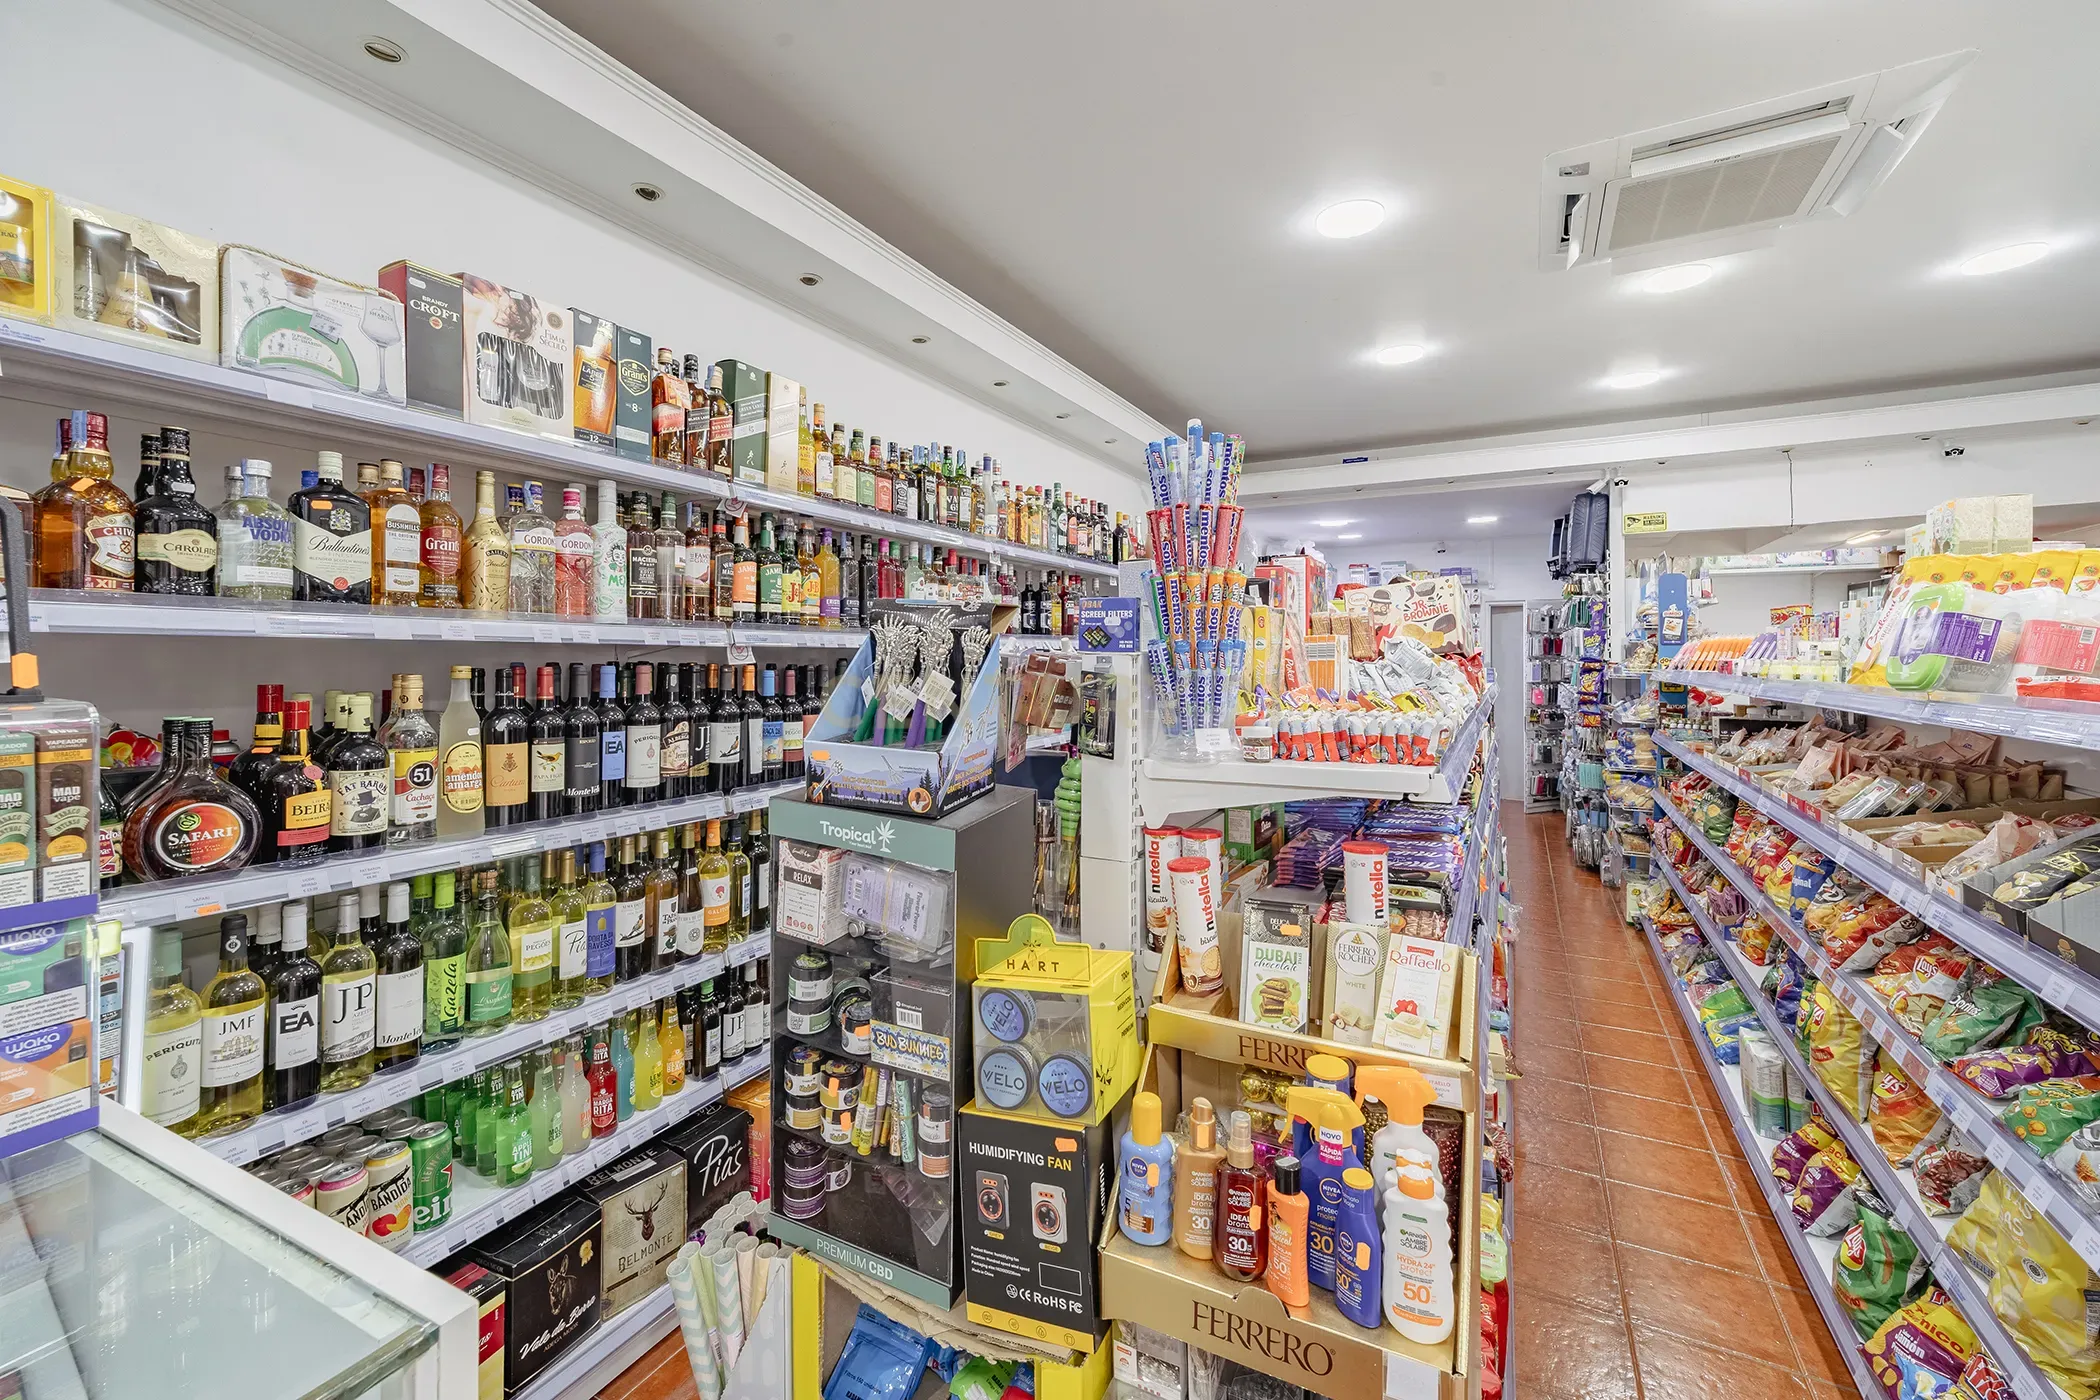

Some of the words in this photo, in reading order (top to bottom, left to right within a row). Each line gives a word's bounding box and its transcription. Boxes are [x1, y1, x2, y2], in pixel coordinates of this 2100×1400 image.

[421, 294, 448, 308] BRANDY
[409, 298, 460, 324] CROFT
[622, 366, 648, 382] Grant's
[632, 403, 638, 412] 8
[589, 434, 599, 444] 12
[1218, 442, 1233, 498] mentos
[387, 520, 420, 532] BUSHMILLS
[308, 535, 370, 556] Ballantine's
[1200, 510, 1212, 568] mentos
[96, 578, 117, 589] XII
[1080, 610, 1106, 618] SCREEN
[1108, 610, 1133, 619] FILTERS
[1156, 580, 1171, 635] mentos
[1170, 579, 1183, 635] mentos
[1403, 602, 1449, 622] BROWNIE
[1080, 618, 1086, 626] 3
[1197, 676, 1206, 729] mentos
[45, 738, 88, 746] VAPEADOR
[412, 769, 432, 783] 51
[53, 786, 81, 796] MAD
[338, 782, 358, 796] FAT
[359, 780, 388, 794] BARON
[566, 786, 590, 796] Monte
[53, 794, 82, 802] vape
[405, 792, 436, 803] Cachaça
[168, 827, 233, 847] SAFARI
[819, 820, 876, 845] Tropical
[1148, 840, 1160, 894] nutella
[793, 870, 812, 885] RELAX
[1370, 860, 1384, 920] nutella
[1198, 874, 1215, 932] nutella
[1256, 947, 1298, 964] DUBAI
[1338, 942, 1377, 958] FERRERO
[1006, 959, 1060, 972] HART
[1254, 958, 1298, 972] chocolate
[1338, 952, 1376, 966] ROCHER
[1389, 950, 1452, 973] Raffaello
[442, 959, 457, 1019] Gazela
[1345, 982, 1366, 990] WHITE
[332, 982, 373, 1024] JP
[1949, 995, 1984, 1016] Doritos
[280, 1011, 315, 1034] EA
[990, 998, 1015, 1032] VELO
[218, 1014, 256, 1036] JMF
[5, 1032, 60, 1054] waka
[381, 1032, 413, 1044] Monte
[876, 1031, 898, 1050] BUD
[898, 1036, 944, 1060] BUNNIES
[983, 1068, 1025, 1091] VELO
[1041, 1078, 1086, 1096] VELO
[593, 1098, 613, 1106] MARGA
[593, 1104, 613, 1116] RITA
[1320, 1131, 1342, 1141] NOVO
[512, 1142, 532, 1154] APPLE
[512, 1149, 532, 1161] TINI
[1320, 1144, 1342, 1157] RÁPIDA
[969, 1141, 1044, 1166] HUMIDIFYING
[1047, 1156, 1072, 1172] FAN
[586, 1148, 657, 1186] BELMONTE
[694, 1133, 742, 1197] Pias
[1132, 1162, 1146, 1170] NIVEA
[370, 1176, 412, 1212] BANDIDA
[1194, 1193, 1212, 1201] IDEAL
[1322, 1184, 1340, 1194] NIVEA
[1326, 1190, 1338, 1198] SUN
[1228, 1198, 1251, 1208] SOLAIRE
[1232, 1194, 1251, 1202] AMBRE
[1192, 1216, 1210, 1230] 30
[1230, 1214, 1250, 1222] IDEAL
[1400, 1228, 1428, 1241] GARNIER
[1404, 1236, 1428, 1247] AMBRE
[1228, 1236, 1248, 1252] 30
[1310, 1232, 1334, 1254] 30
[1400, 1239, 1428, 1252] SOLAIRE
[618, 1230, 673, 1273] BELMONTE
[816, 1238, 868, 1270] PREMIUM
[868, 1259, 893, 1281] CBD
[1274, 1257, 1286, 1274] 50
[1396, 1256, 1422, 1268] HYDRA
[1400, 1264, 1432, 1276] protect
[1033, 1291, 1067, 1310] RoHS
[519, 1330, 550, 1360] Vale
[1192, 1300, 1334, 1376] FERRERO
[1894, 1333, 1926, 1359] Jamón
